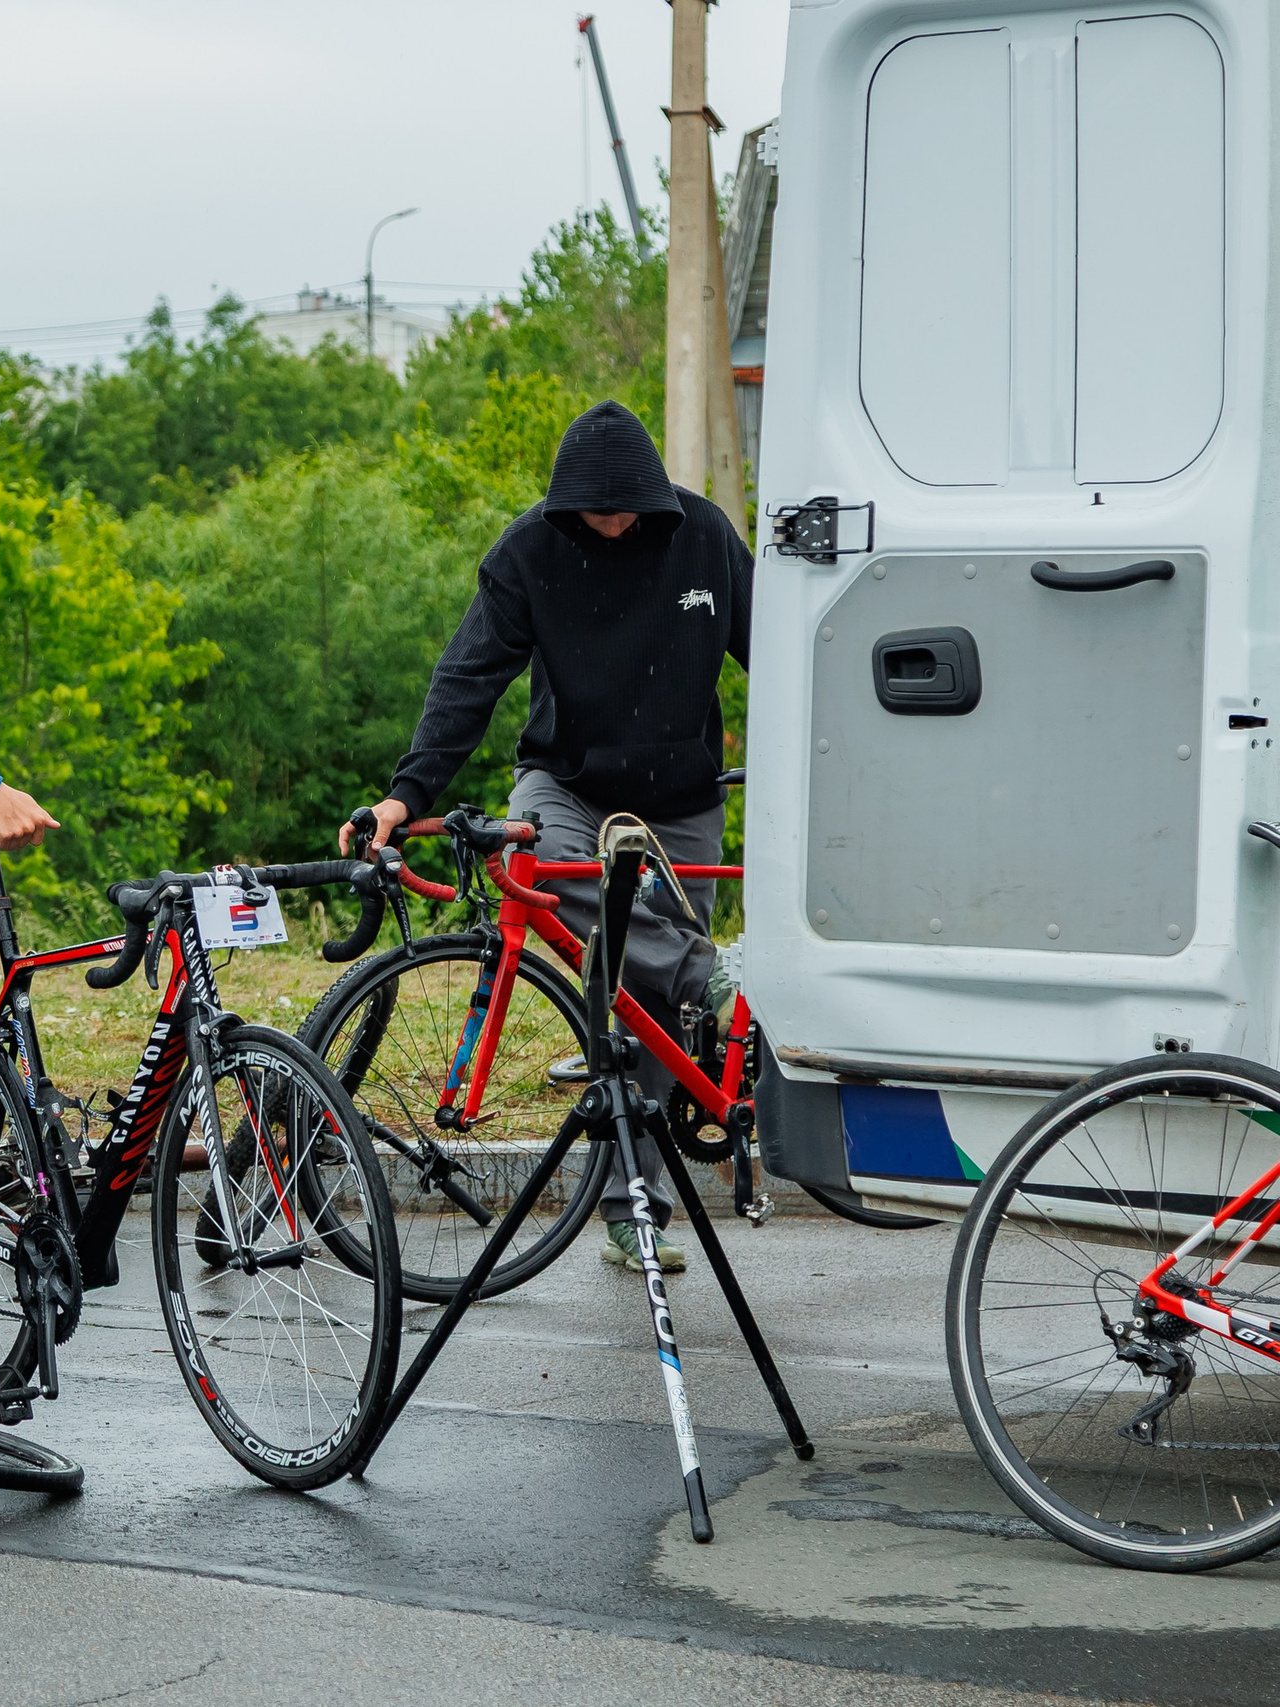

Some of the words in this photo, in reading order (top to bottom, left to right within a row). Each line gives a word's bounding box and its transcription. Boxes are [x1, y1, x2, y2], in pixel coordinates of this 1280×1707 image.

[229, 903, 259, 931] 5
[111, 1022, 171, 1144] CANYON
[170, 1290, 217, 1401] RACE
[242, 1396, 361, 1467] MARCHISIO
